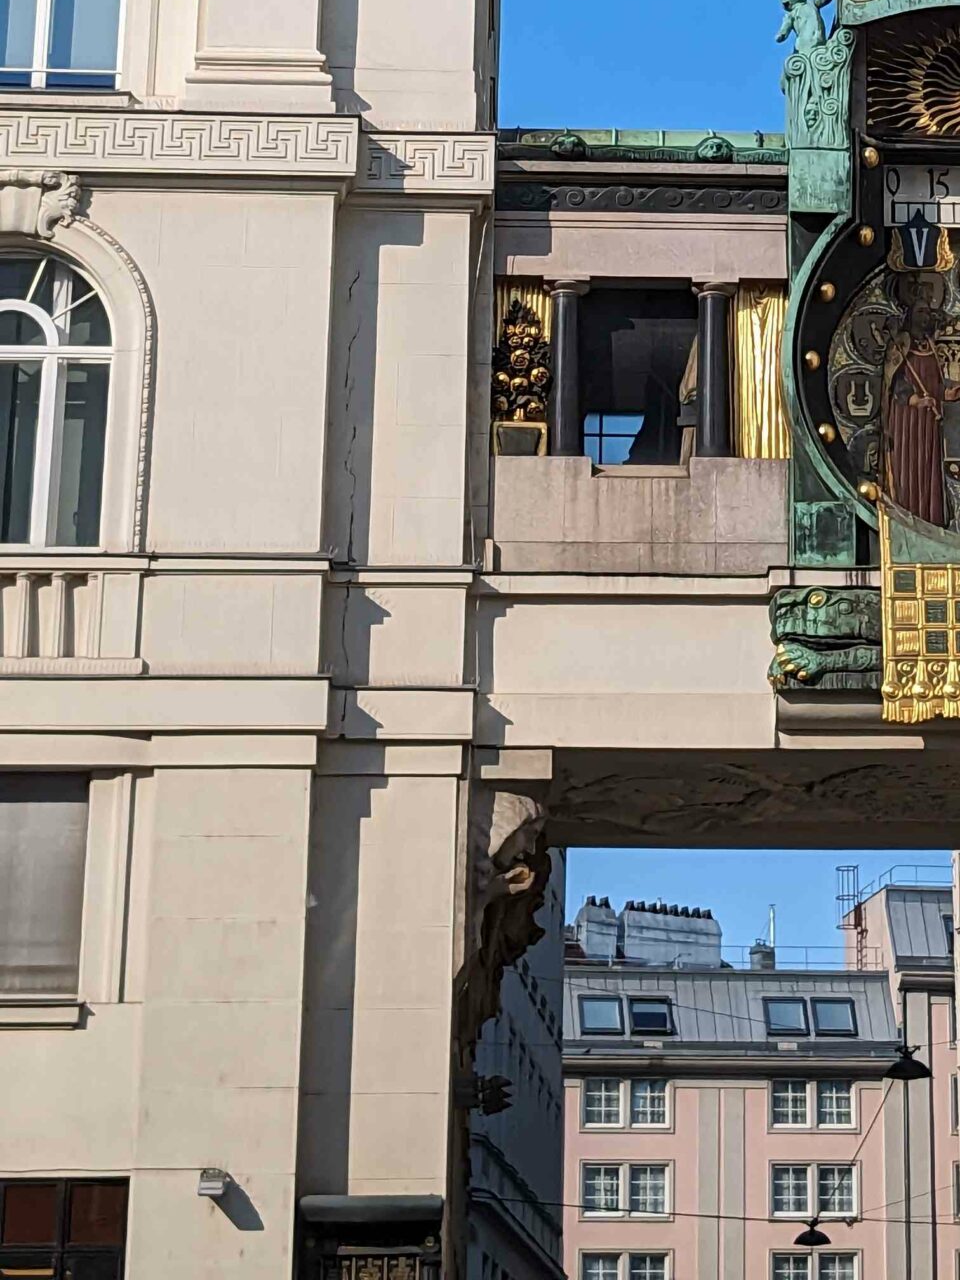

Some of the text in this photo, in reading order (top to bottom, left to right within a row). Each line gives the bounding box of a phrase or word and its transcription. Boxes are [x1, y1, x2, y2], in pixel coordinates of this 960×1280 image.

[886, 169, 900, 197] 0
[927, 169, 950, 199] 15
[909, 227, 929, 267] V
